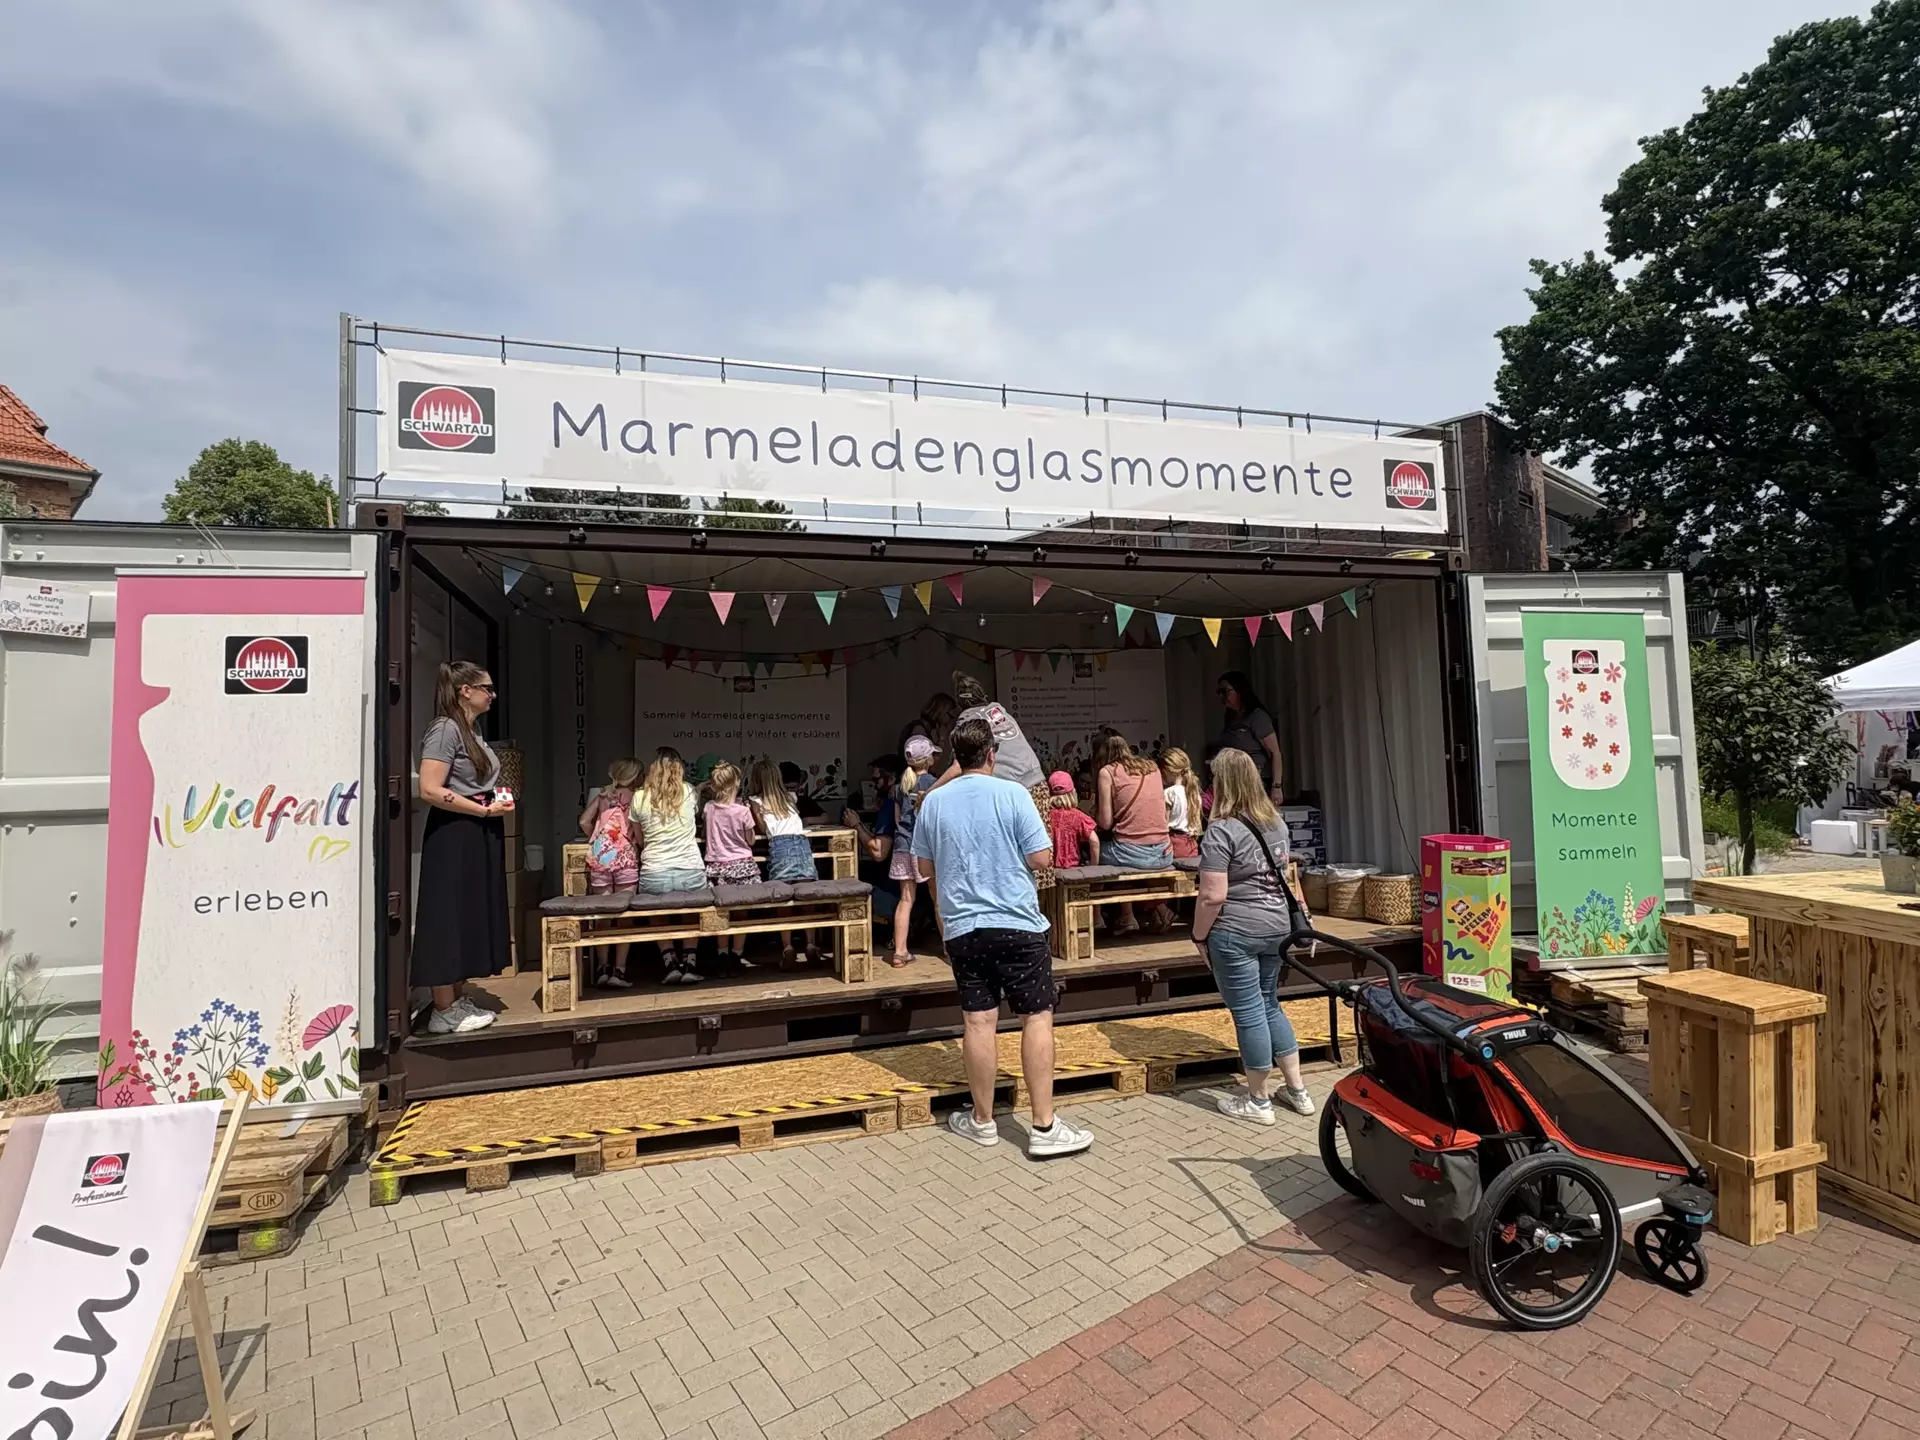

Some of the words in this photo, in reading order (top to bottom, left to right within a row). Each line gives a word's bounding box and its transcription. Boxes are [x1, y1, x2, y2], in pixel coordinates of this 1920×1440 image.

[404, 418, 490, 436] SCHWARTAU
[553, 400, 1353, 499] Marmeladenglasmomente
[1387, 487, 1434, 498] SCHWARTAU
[26, 594, 64, 605] Achtung
[229, 668, 303, 679] SCHWARTAU
[574, 645, 585, 707] BCHU
[643, 710, 686, 720] Sammle
[691, 710, 831, 722] Marmeladenglasmomente
[673, 730, 693, 739] und
[698, 730, 720, 739] lass
[725, 730, 742, 739] die
[747, 730, 787, 739] Vielfalt
[792, 729, 841, 739] erblühen!
[183, 780, 359, 843] Vielfalt
[1552, 812, 1637, 828] Momente
[1558, 844, 1637, 861] sammeln
[194, 889, 329, 914] erleben
[1458, 911, 1476, 926] WIR
[1465, 907, 1493, 933] FEIERN
[1472, 911, 1500, 944] 125
[1451, 976, 1470, 986] 125
[1502, 1028, 1527, 1040] THULE
[71, 1184, 128, 1204] Professional
[255, 1193, 277, 1209] EUR
